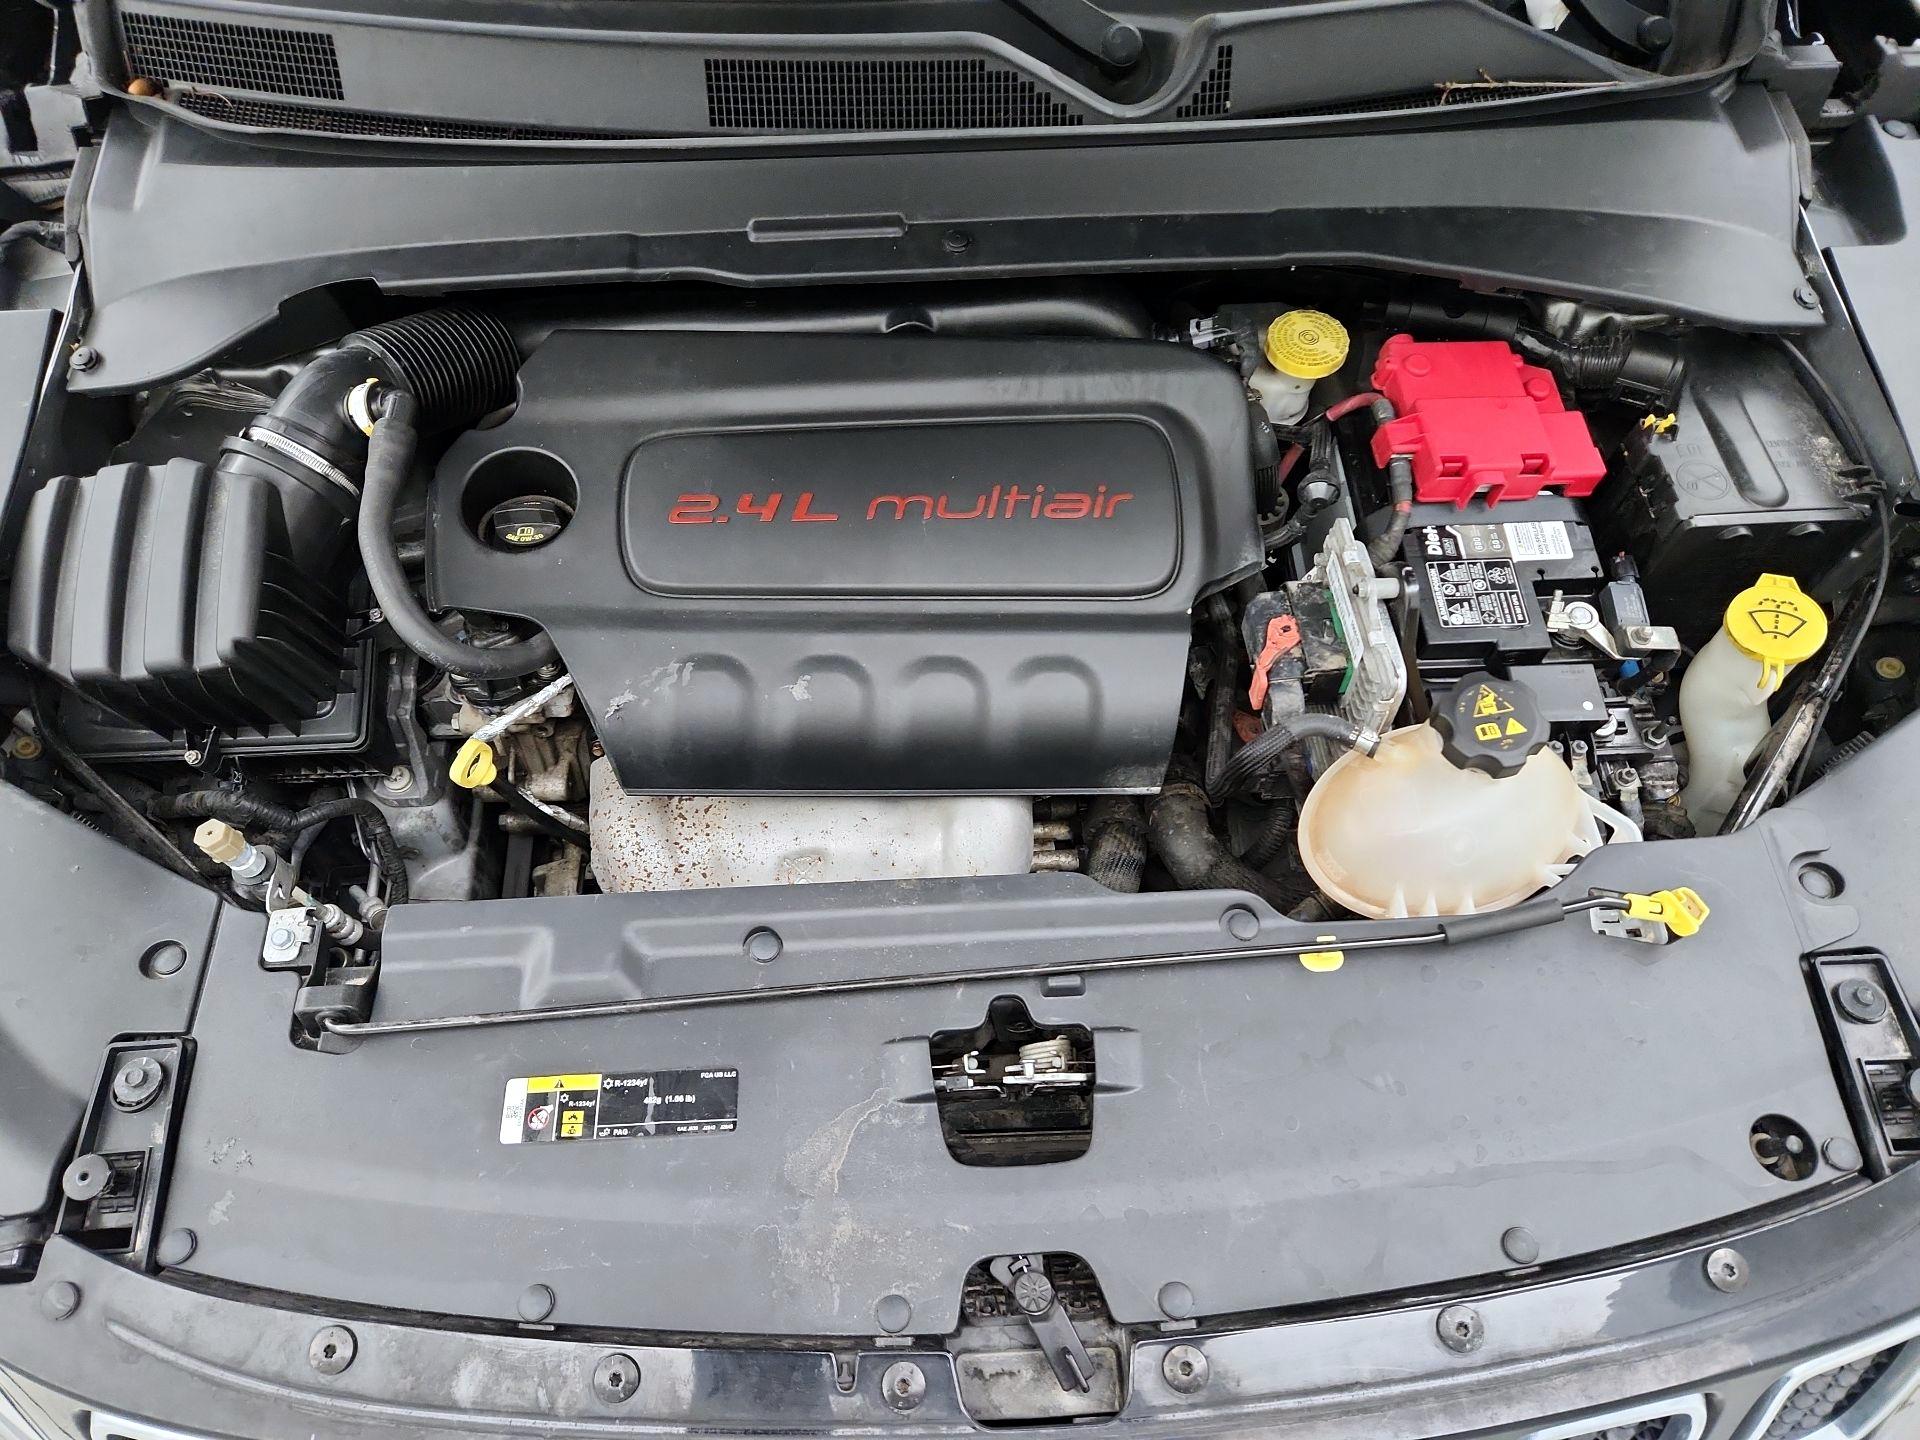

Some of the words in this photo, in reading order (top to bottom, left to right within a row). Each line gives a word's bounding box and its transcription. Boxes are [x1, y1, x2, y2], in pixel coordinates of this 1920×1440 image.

[865, 484, 1135, 520] multiair
[614, 1078, 649, 1088] R-1234yf
[568, 1099, 596, 1108] R-1234yf
[684, 1095, 696, 1104] lb)
[613, 1128, 629, 1136] PAG
